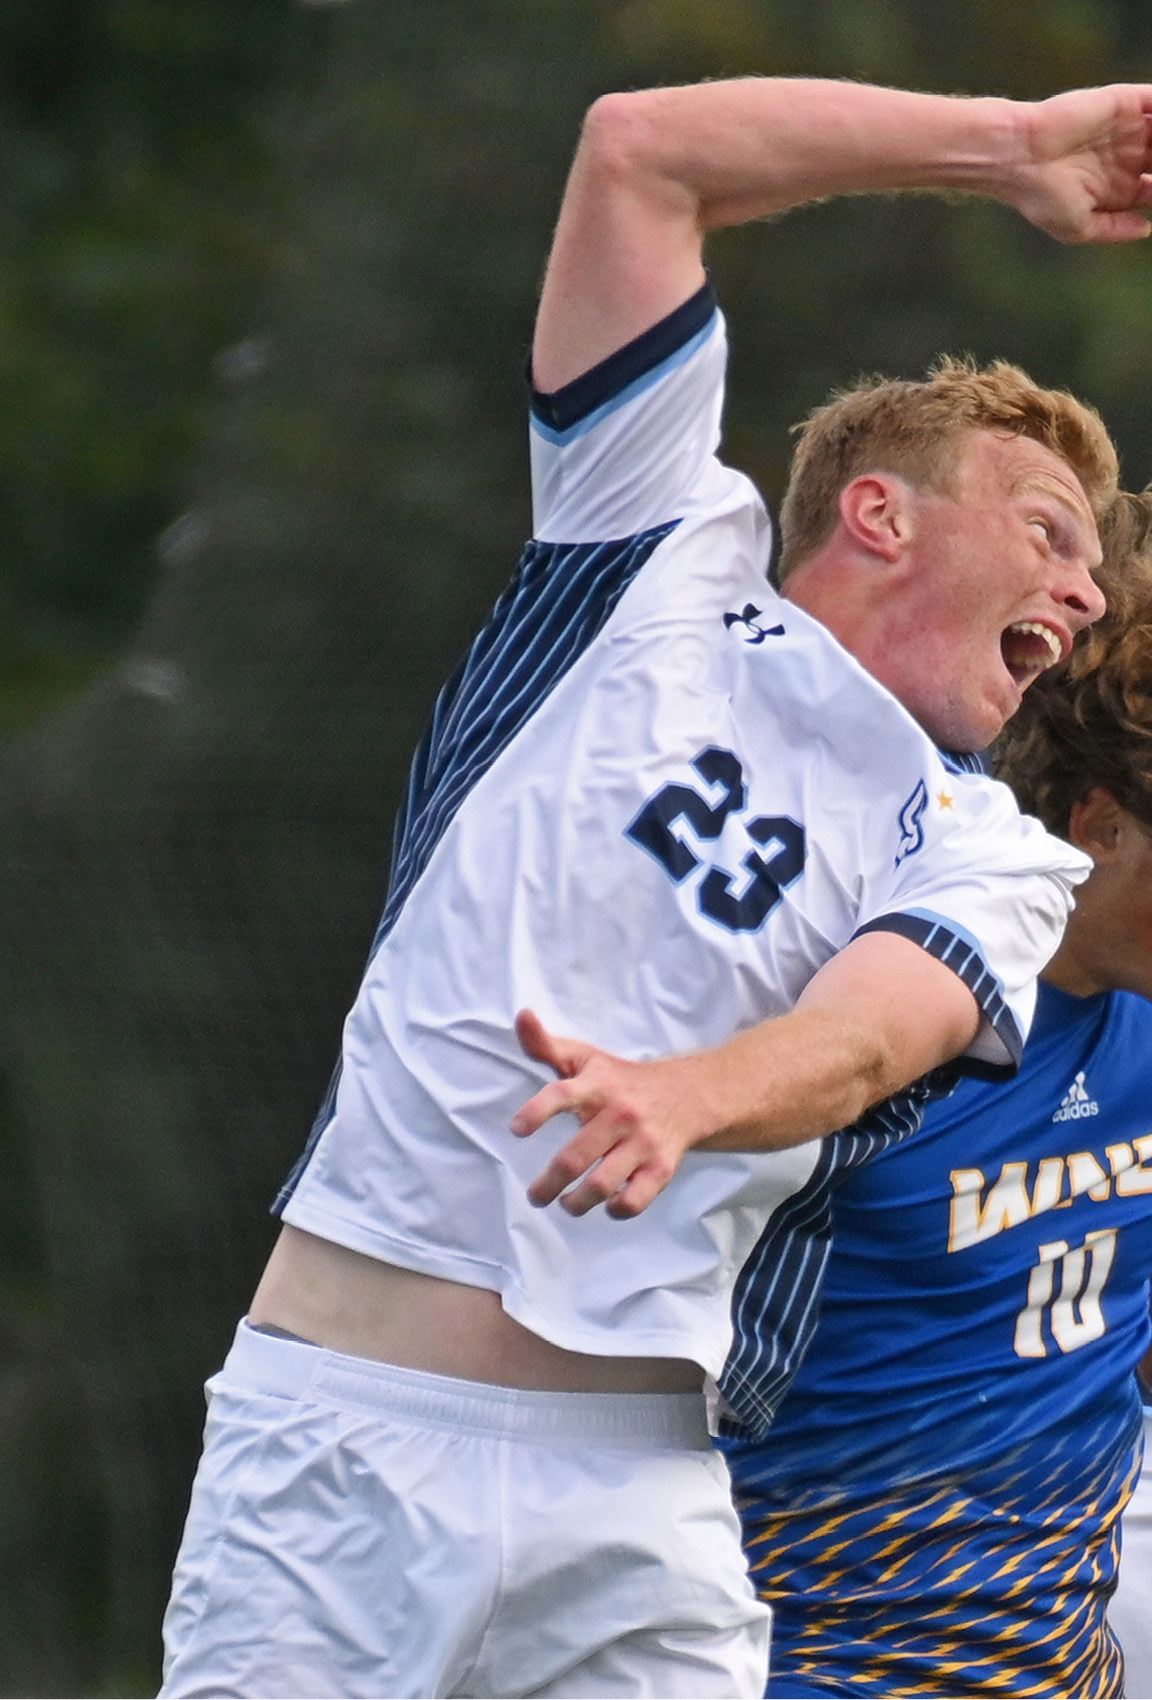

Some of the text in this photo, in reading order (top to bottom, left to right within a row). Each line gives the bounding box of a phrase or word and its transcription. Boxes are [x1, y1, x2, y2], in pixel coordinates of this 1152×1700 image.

[622, 744, 809, 936] 23
[1052, 1101, 1099, 1123] adidas
[1013, 1228, 1119, 1358] 10
